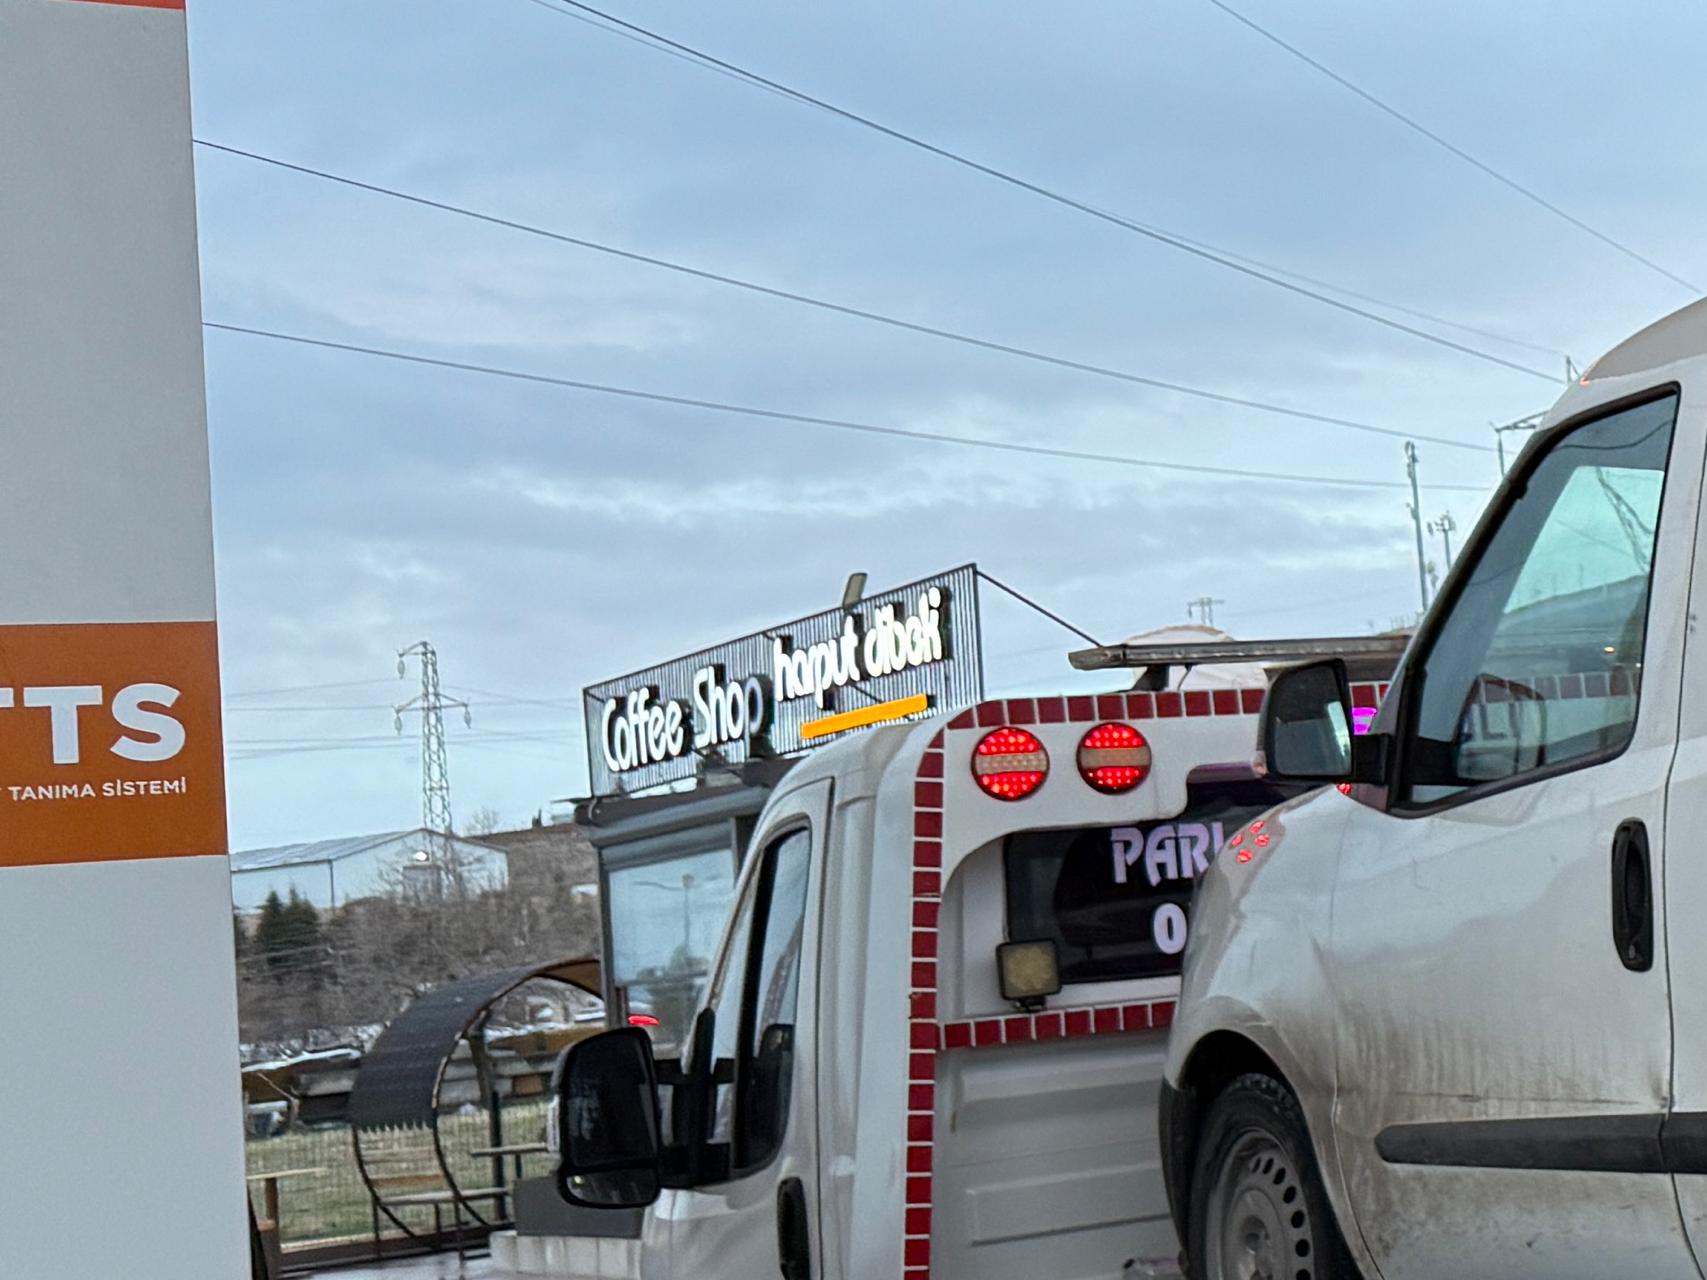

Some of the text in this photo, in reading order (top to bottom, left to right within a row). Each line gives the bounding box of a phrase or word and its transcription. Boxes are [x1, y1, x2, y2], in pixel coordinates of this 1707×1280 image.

[0, 682, 187, 764] TS
[602, 686, 684, 773] Coffee
[692, 665, 764, 758] Shop
[773, 616, 860, 710] harput
[8, 776, 187, 801] TANIMA SİSTEMİ
